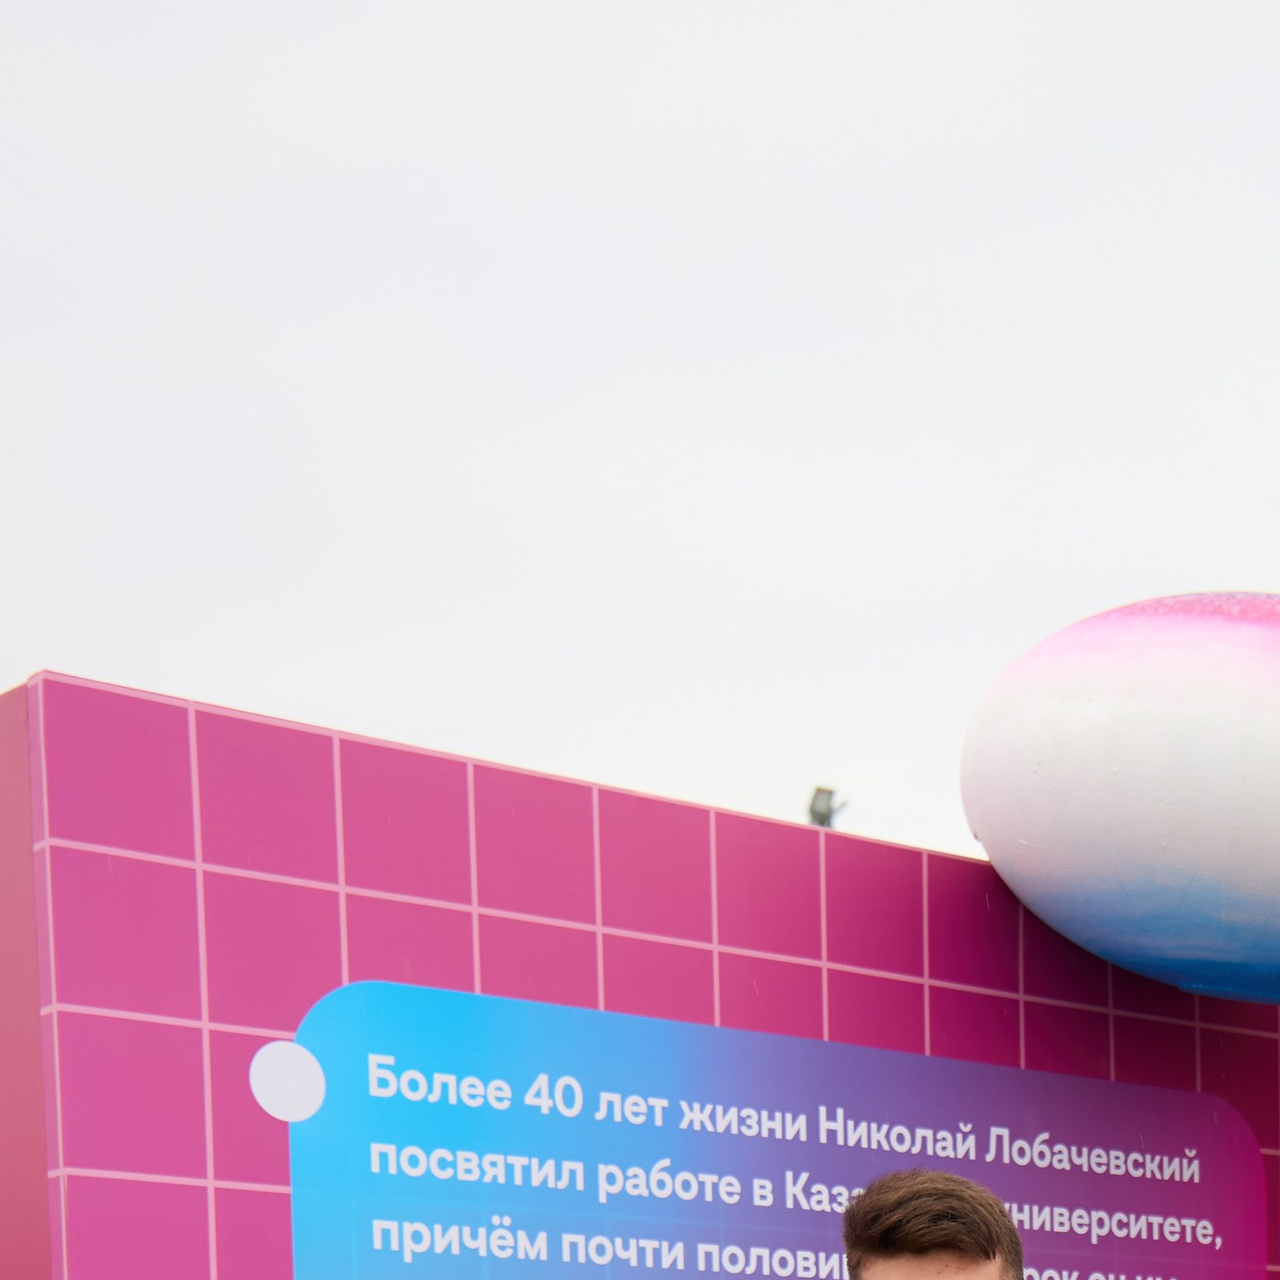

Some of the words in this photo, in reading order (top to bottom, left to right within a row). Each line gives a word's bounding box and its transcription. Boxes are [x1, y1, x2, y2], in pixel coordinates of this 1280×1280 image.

[367, 1053, 512, 1111] Более
[523, 1072, 584, 1118] 40
[594, 1090, 669, 1128] лет
[679, 1100, 807, 1142] жизни
[818, 1105, 976, 1160] Николай
[985, 1126, 1200, 1184] Лобачевский
[370, 1142, 585, 1192] посвятил
[599, 1158, 741, 1205] работе
[752, 1178, 774, 1207] в
[1002, 1202, 1222, 1250] ниверситете,
[372, 1214, 549, 1264] причём
[561, 1233, 685, 1270] почти
